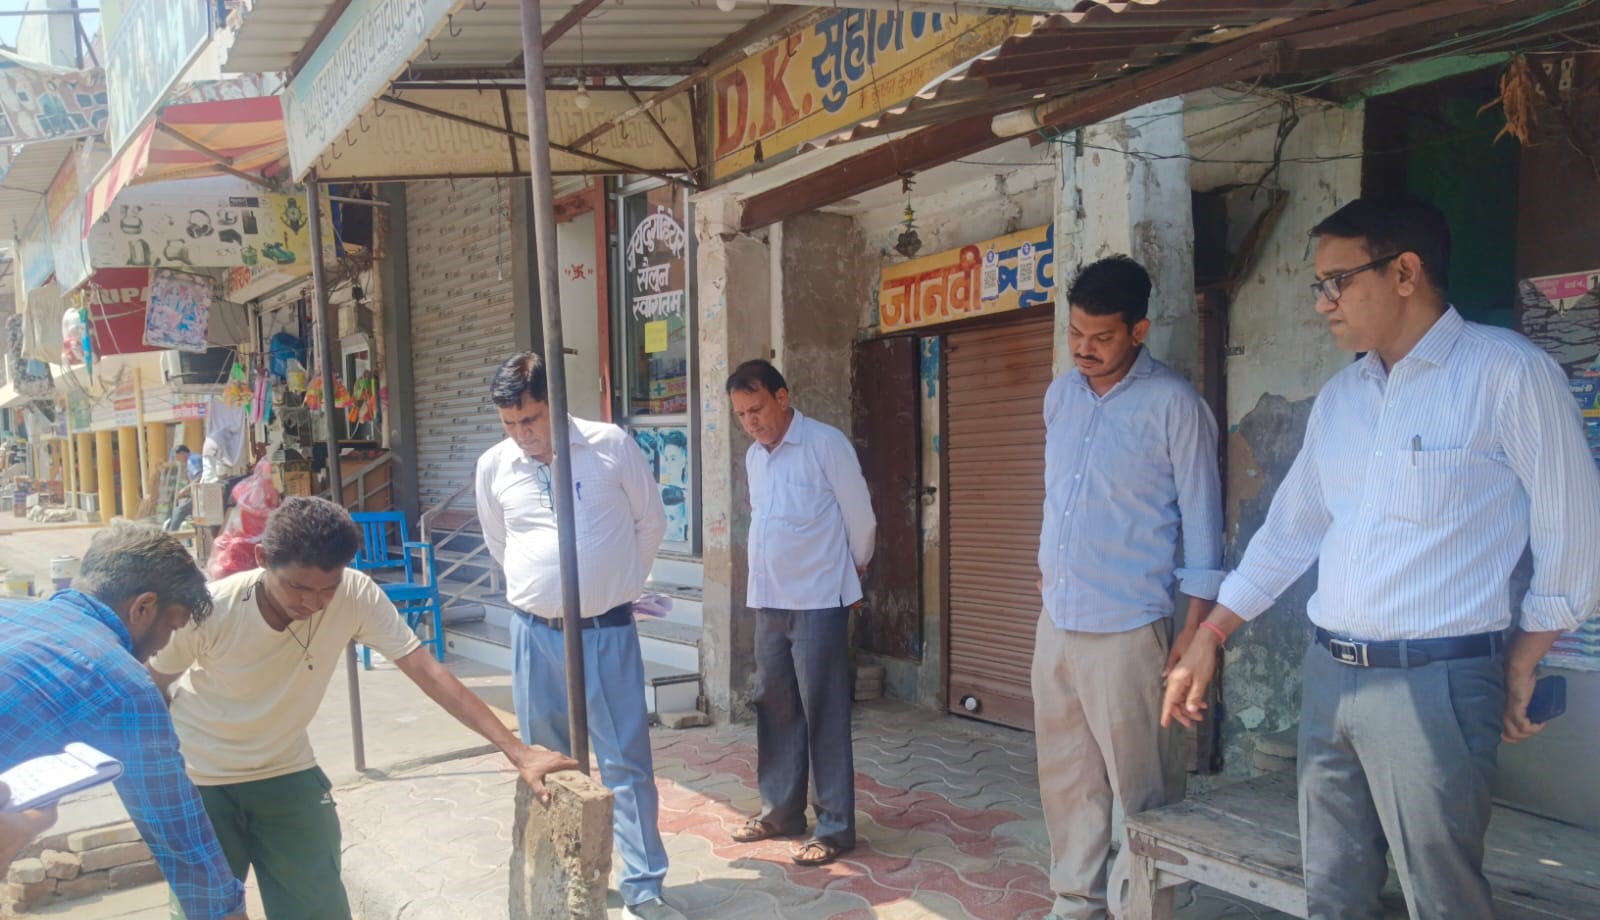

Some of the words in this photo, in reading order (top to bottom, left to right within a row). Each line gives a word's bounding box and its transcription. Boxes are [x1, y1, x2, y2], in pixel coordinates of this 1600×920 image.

[636, 257, 671, 292] सैलून
[881, 244, 983, 327] जानवी
[632, 290, 684, 321] स्वागतम्
